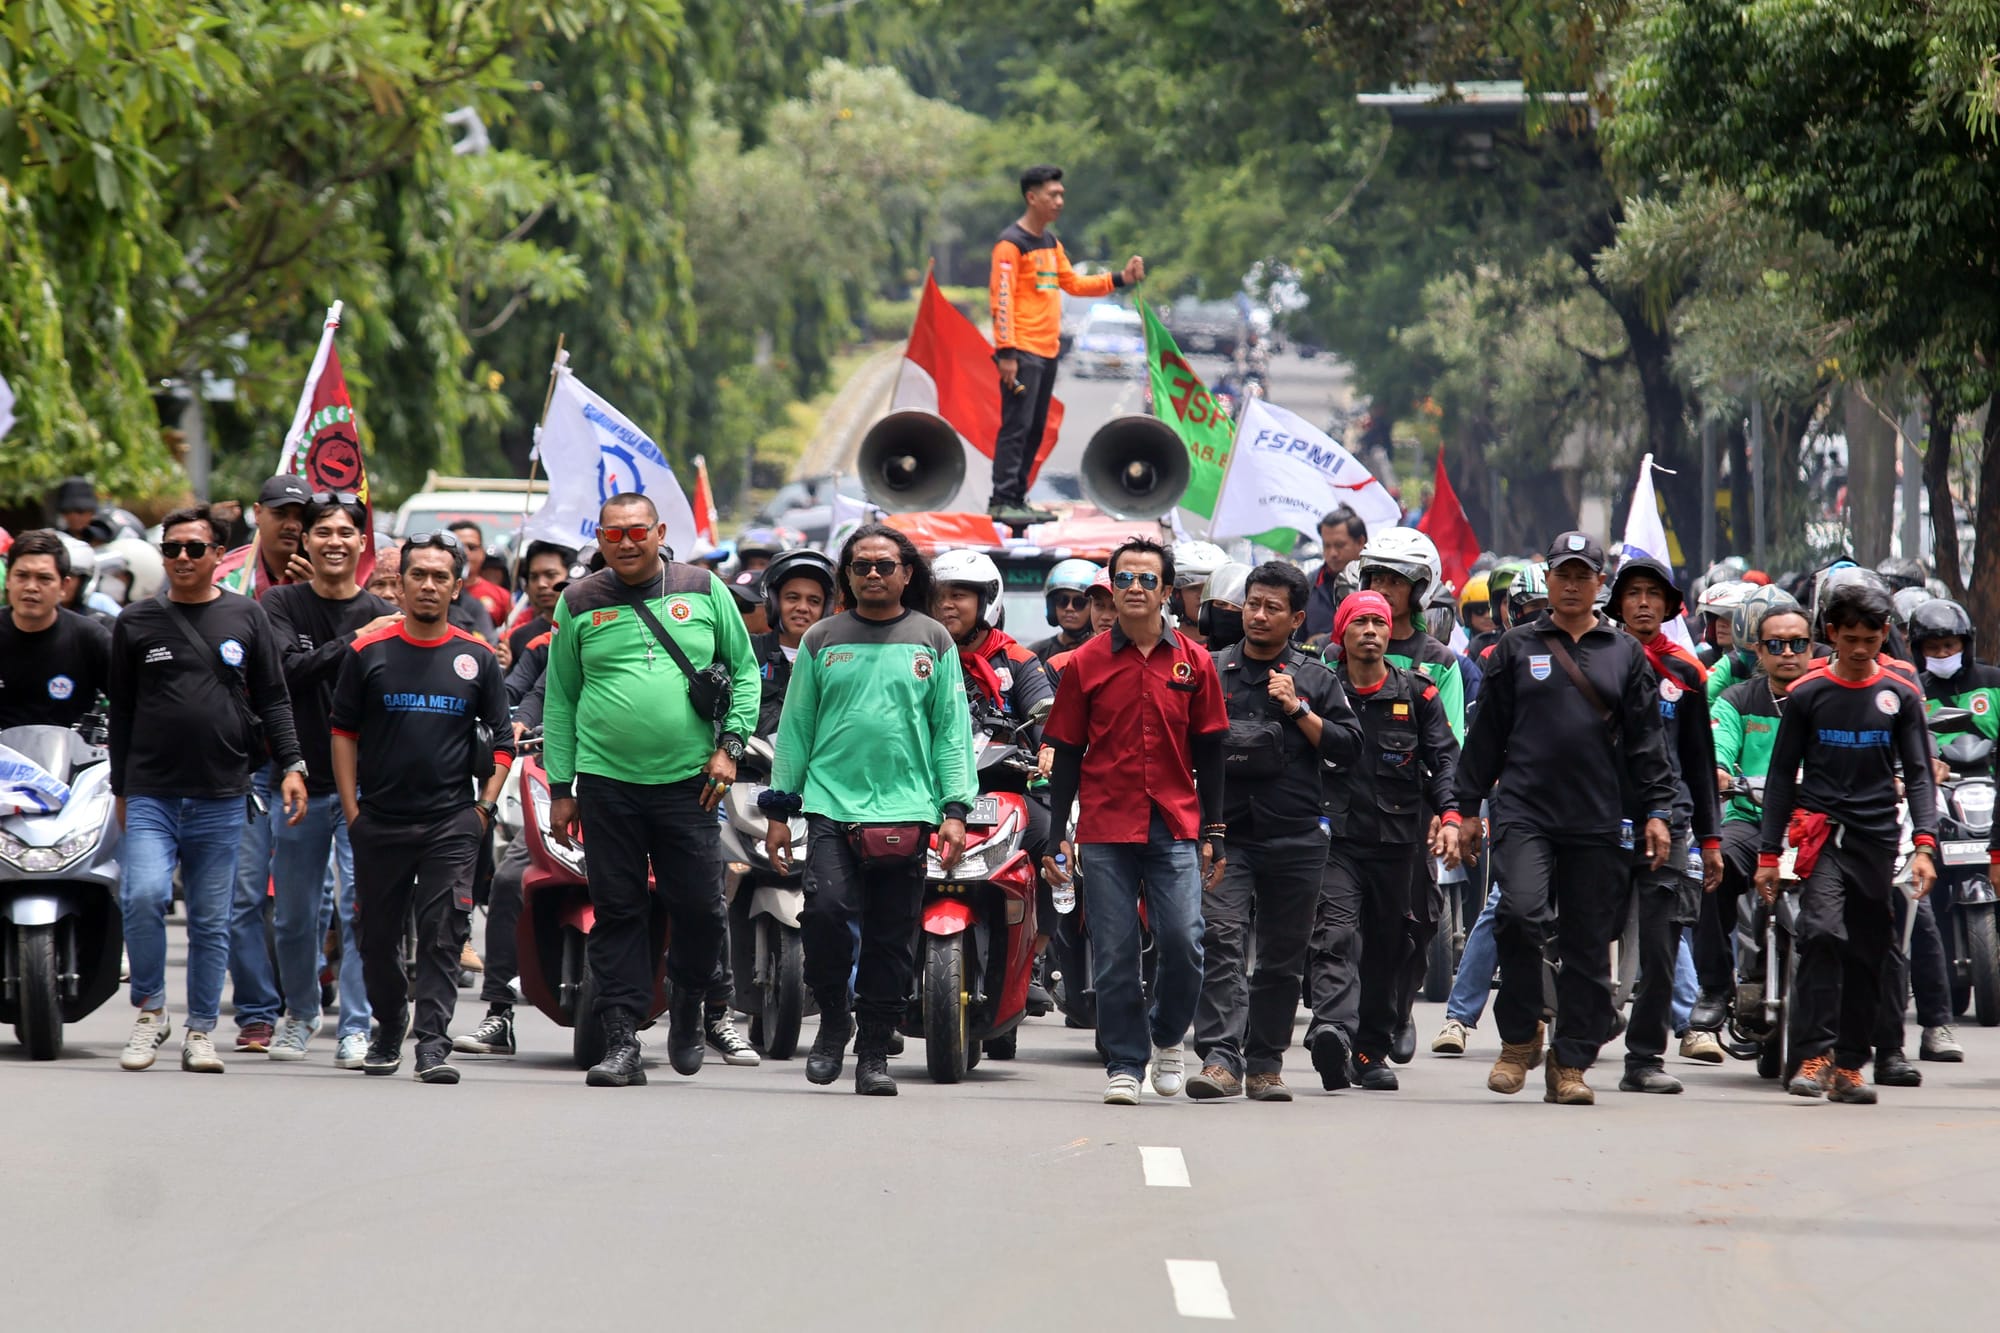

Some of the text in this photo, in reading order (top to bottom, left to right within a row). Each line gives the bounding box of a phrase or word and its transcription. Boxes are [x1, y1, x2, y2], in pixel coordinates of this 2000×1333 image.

[1254, 429, 1345, 475] FSPMI
[383, 693, 426, 707] GARDA
[1818, 729, 1890, 744] GARDA META
